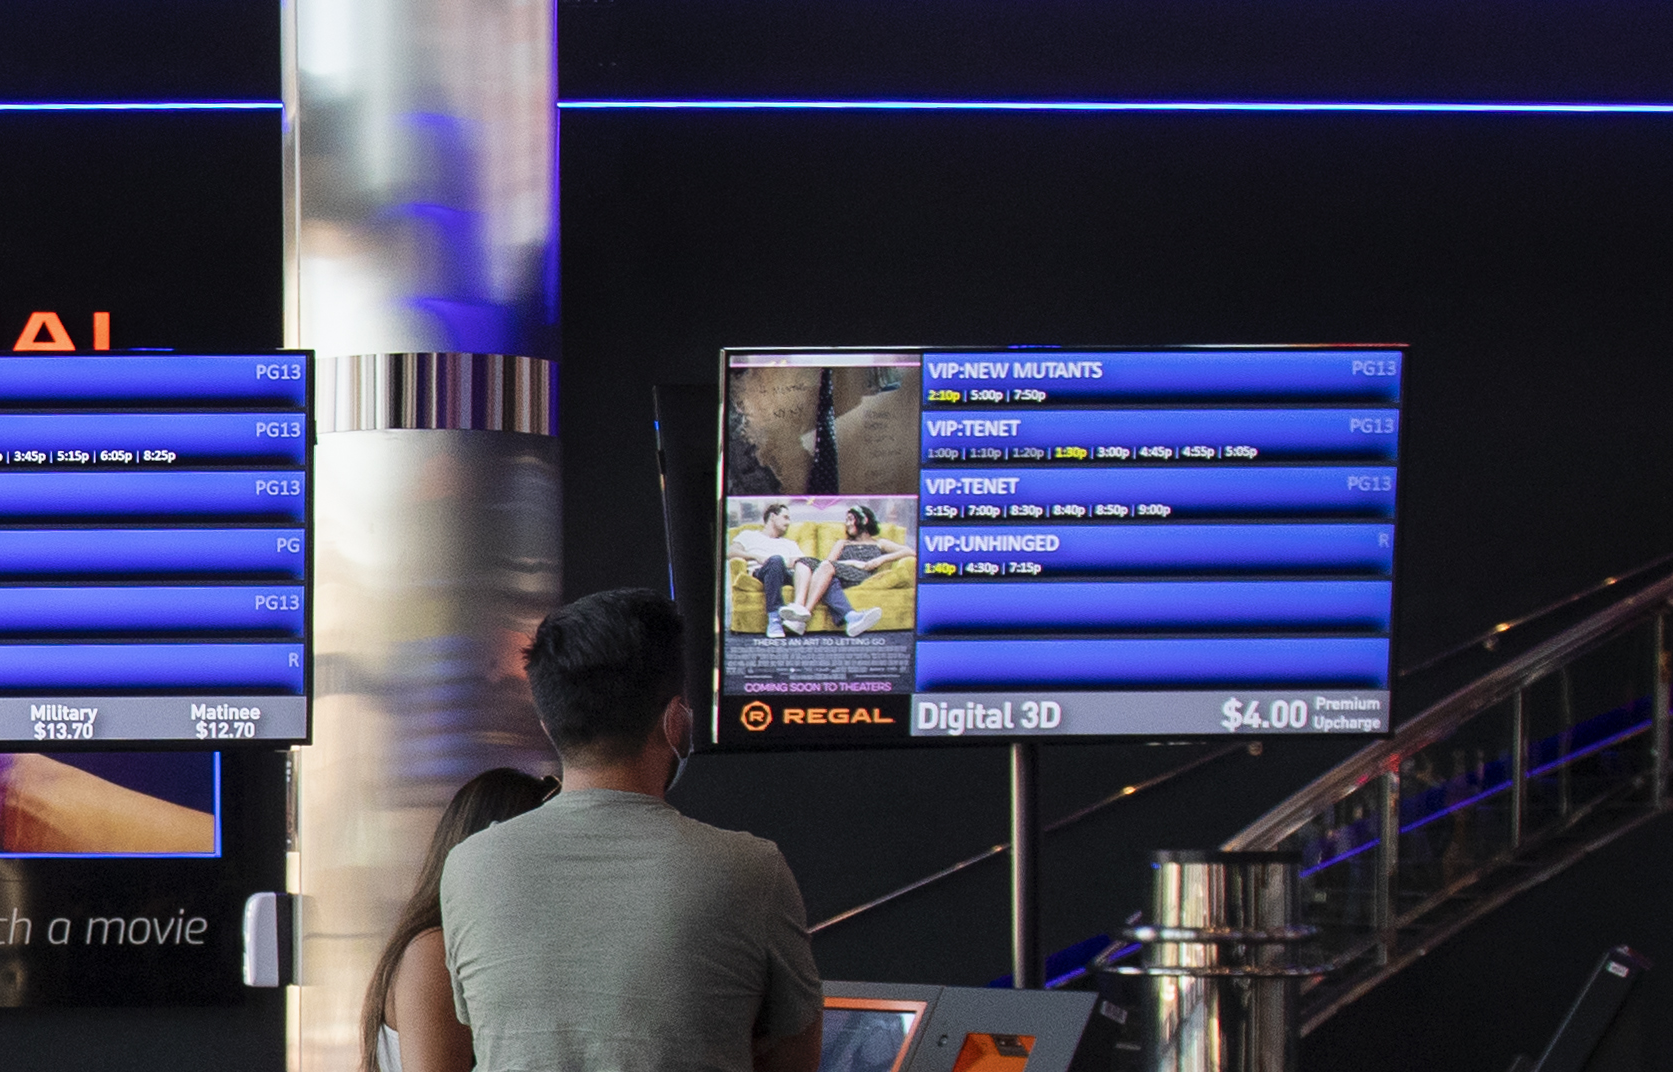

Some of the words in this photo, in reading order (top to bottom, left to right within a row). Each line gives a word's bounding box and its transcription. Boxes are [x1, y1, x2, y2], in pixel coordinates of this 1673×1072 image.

[256, 364, 301, 380] PG13
[928, 362, 1009, 379] VIP:NEW
[1013, 362, 1103, 379] MUTANTS
[1352, 360, 1396, 376] PG13
[256, 422, 301, 437] PG13
[927, 420, 1021, 437] VIP:TENET
[1350, 418, 1394, 433] PG13
[13, 451, 46, 463] 3:45p
[57, 451, 89, 463] 5:15p
[100, 450, 133, 463] 6:05p
[143, 450, 176, 463] 8:25p
[256, 480, 300, 495] PG13
[926, 477, 1019, 495] VIP:TENET
[1347, 476, 1391, 491] PG13
[277, 538, 300, 553] PG
[924, 535, 1059, 552] VIP:UNHINGED
[1378, 533, 1390, 548] R
[255, 595, 299, 610] PG13
[289, 653, 299, 667] R
[744, 683, 788, 692] COMING
[790, 683, 821, 692] SOON
[823, 682, 838, 692] TO
[840, 682, 892, 692] THEATERS
[1315, 696, 1380, 711] Premium
[30, 705, 98, 724] Military
[191, 704, 261, 720] Matinee
[783, 708, 894, 724] REGAL
[918, 701, 1014, 735] Digital
[1020, 701, 1061, 729] 3D
[1221, 697, 1307, 732] $4.00
[34, 722, 94, 741] $13.70
[196, 720, 255, 739] $12.70
[1314, 715, 1381, 732] Upcharge
[47, 917, 70, 946] a
[85, 910, 208, 946] movie
